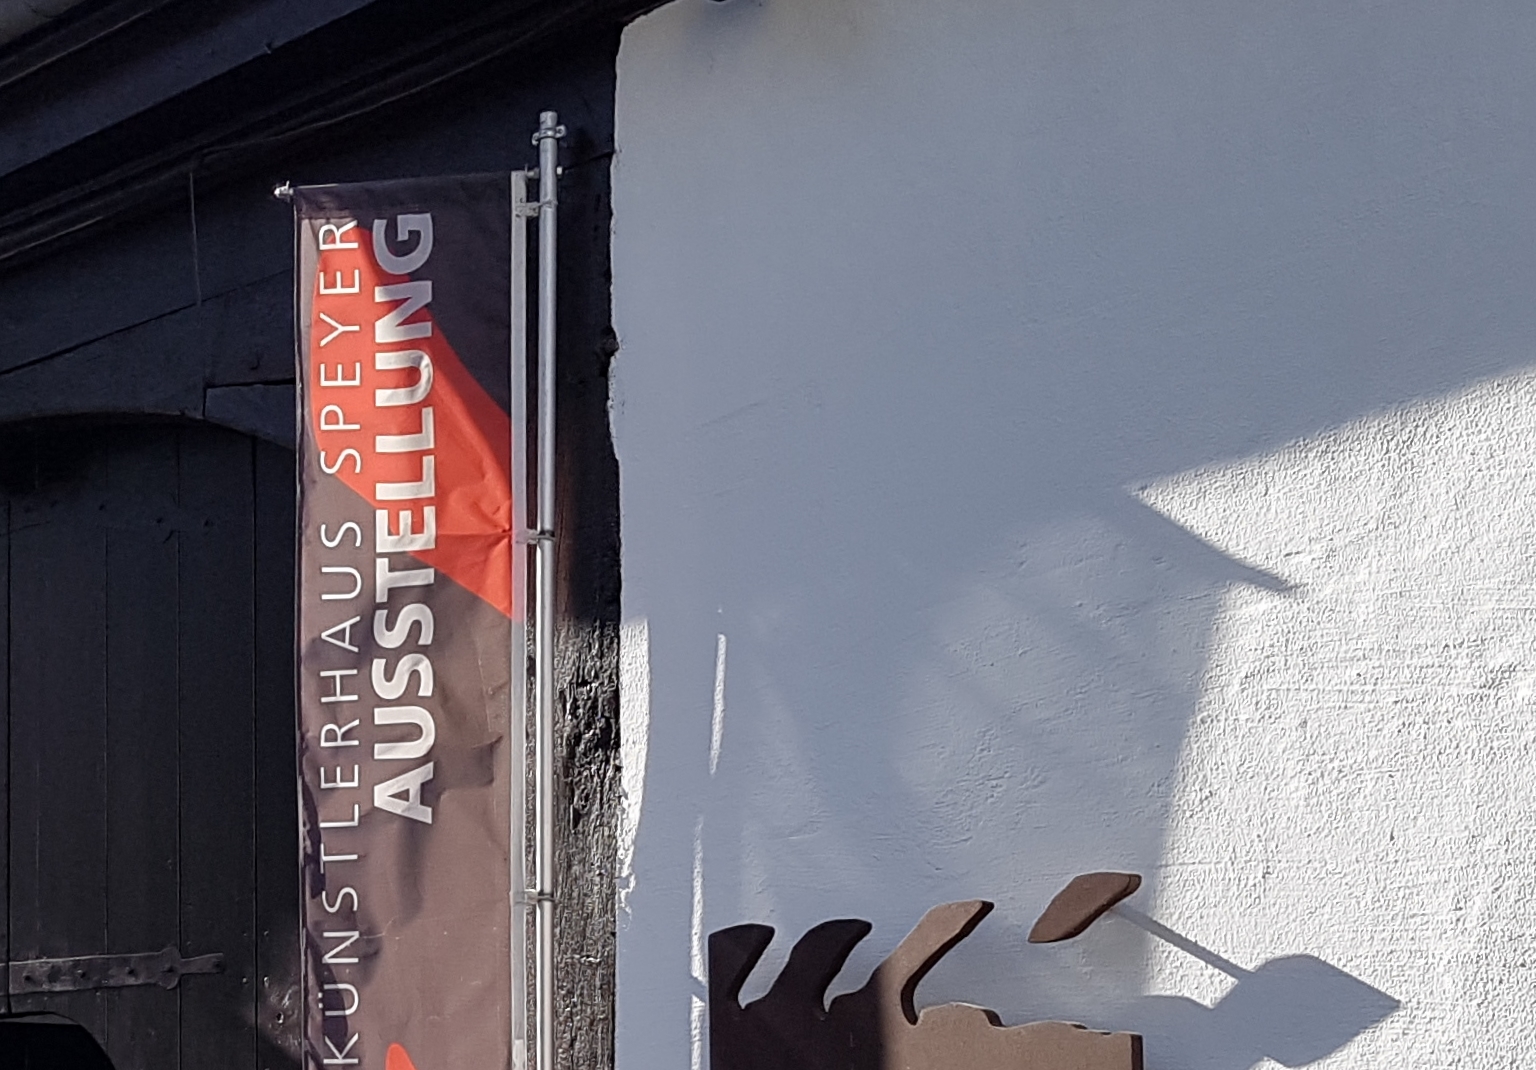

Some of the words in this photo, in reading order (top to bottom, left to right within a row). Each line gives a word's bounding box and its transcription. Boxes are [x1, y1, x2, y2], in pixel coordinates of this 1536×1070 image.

[318, 219, 362, 475] SPEYER
[371, 211, 437, 825] AUSSTELLUNG
[318, 520, 363, 1067] KÜNSTLERHAUS
